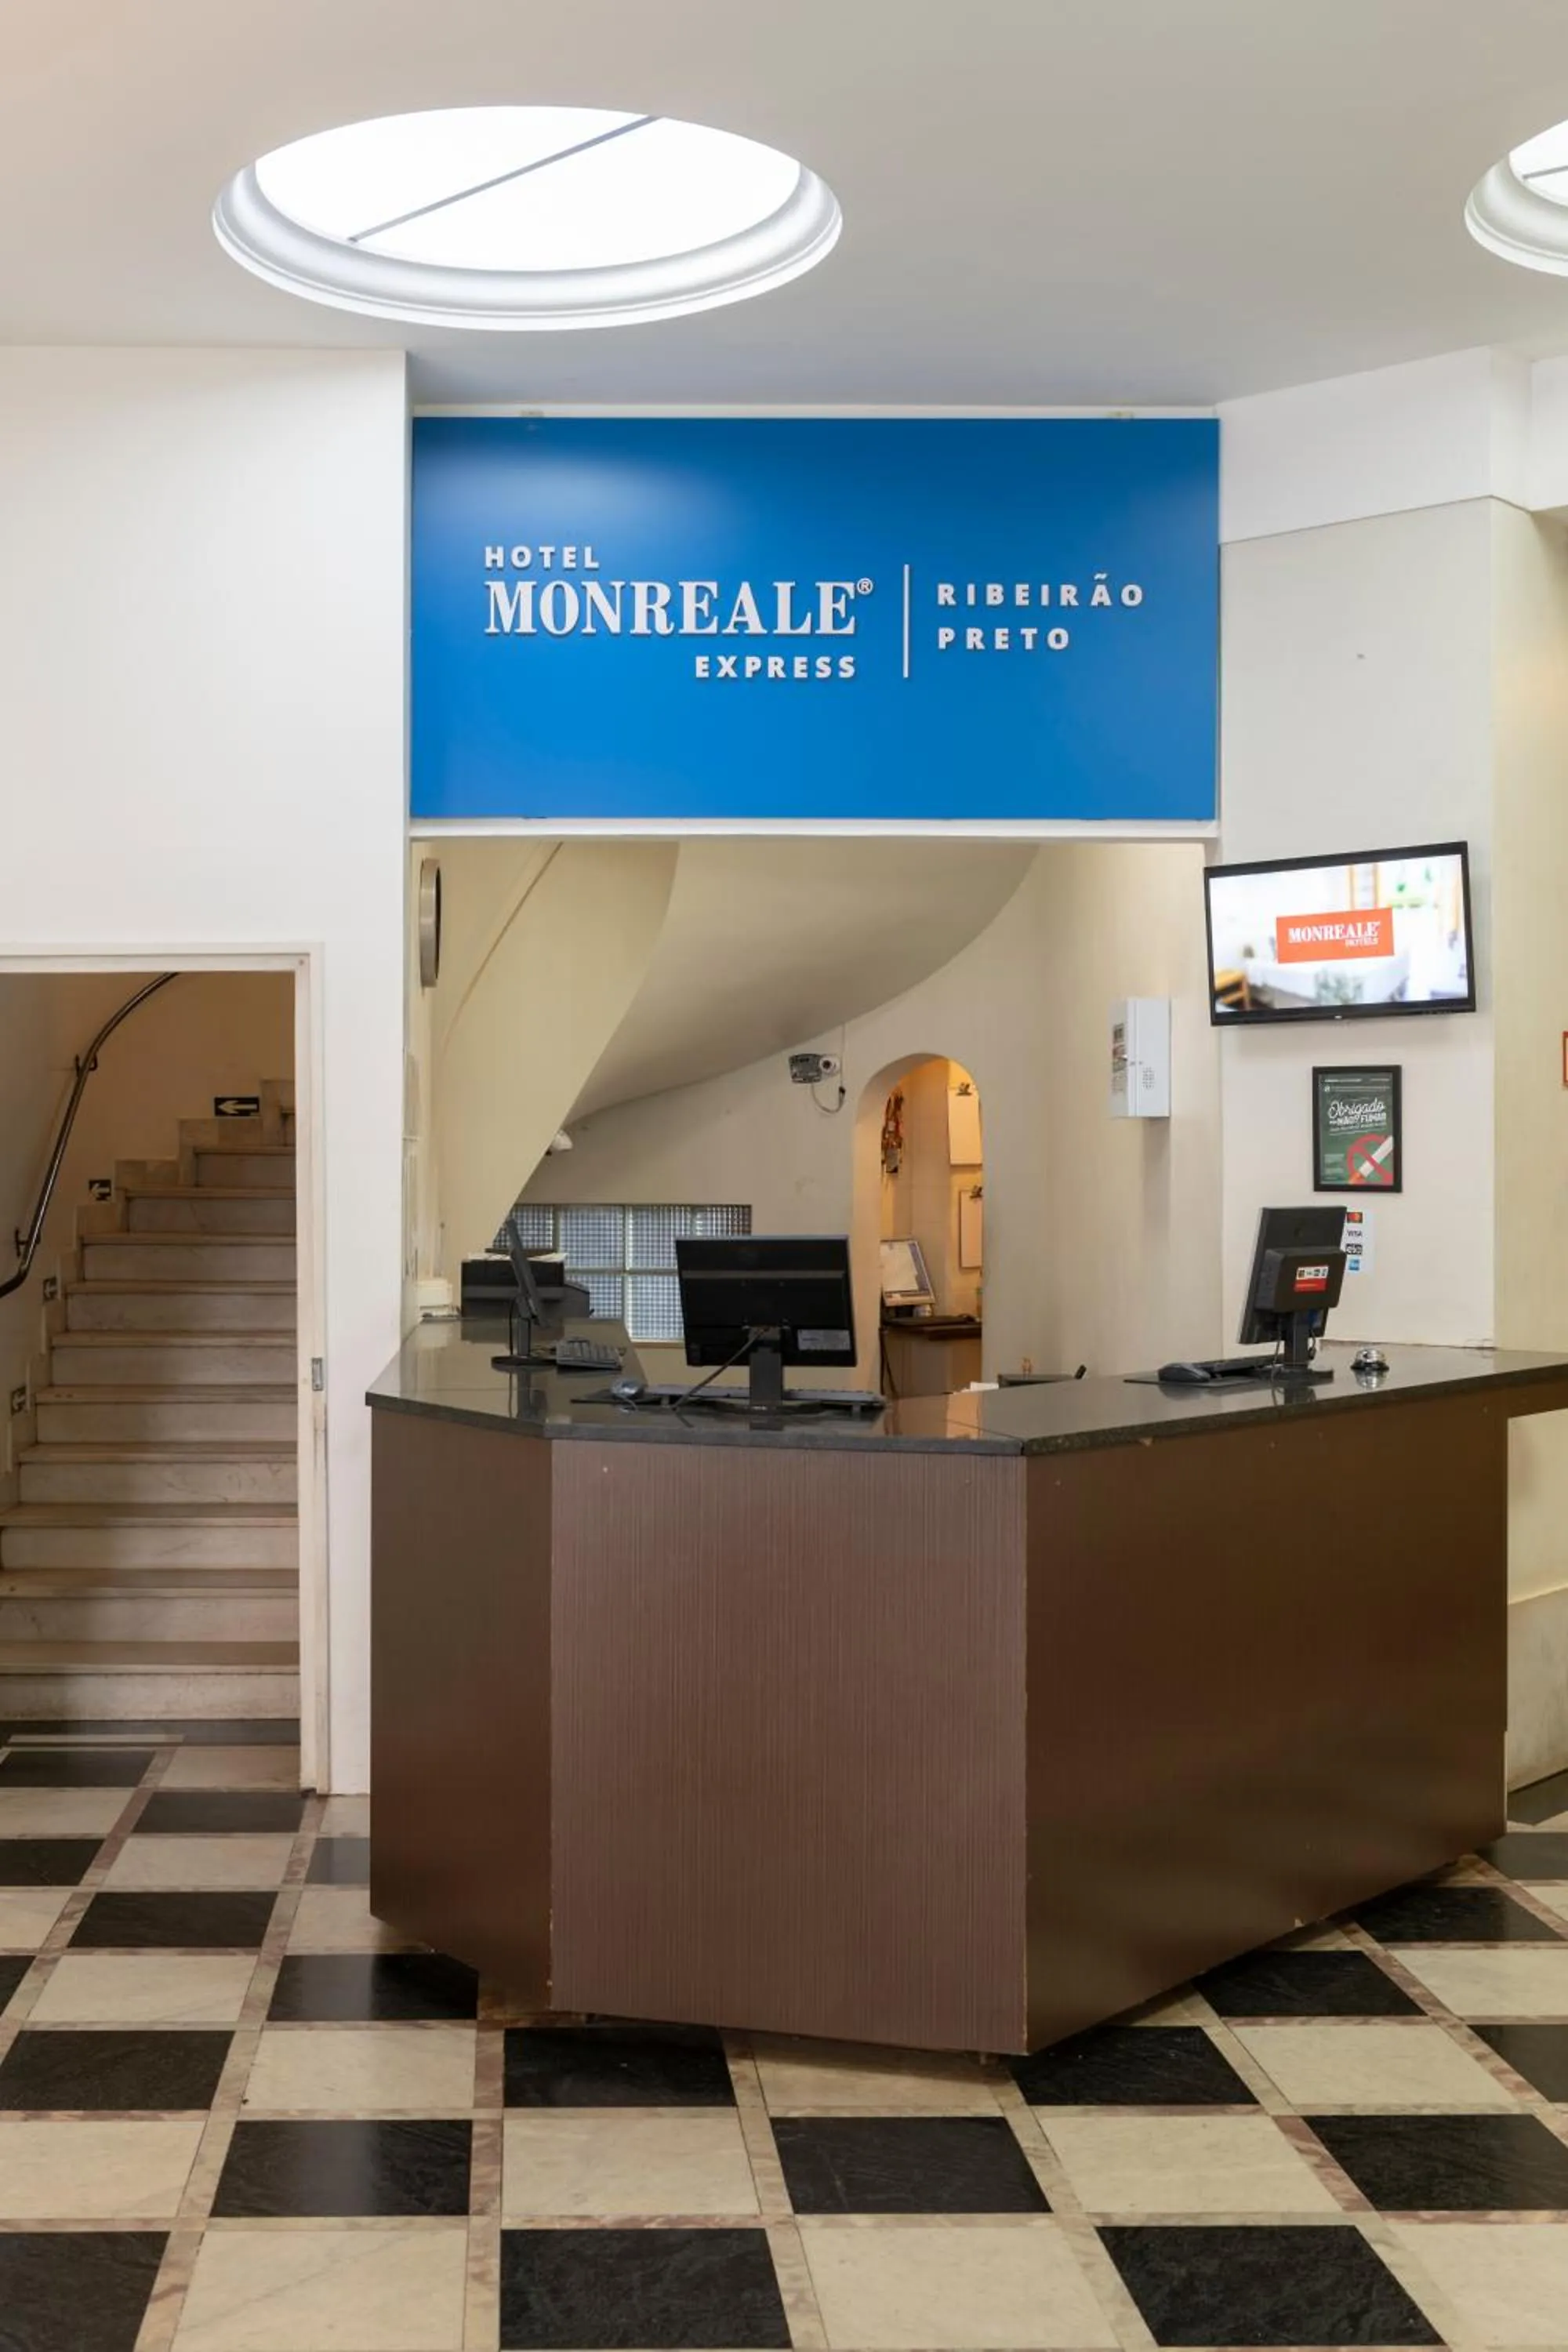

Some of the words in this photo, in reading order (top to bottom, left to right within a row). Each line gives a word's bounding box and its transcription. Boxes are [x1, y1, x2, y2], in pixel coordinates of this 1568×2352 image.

[484, 546, 600, 569] HOTEL
[937, 573, 1143, 607] RIBEIRÃO
[937, 627, 1069, 650] PRETO
[695, 656, 856, 679] EXPRESS
[1288, 921, 1380, 943] MONREALE
